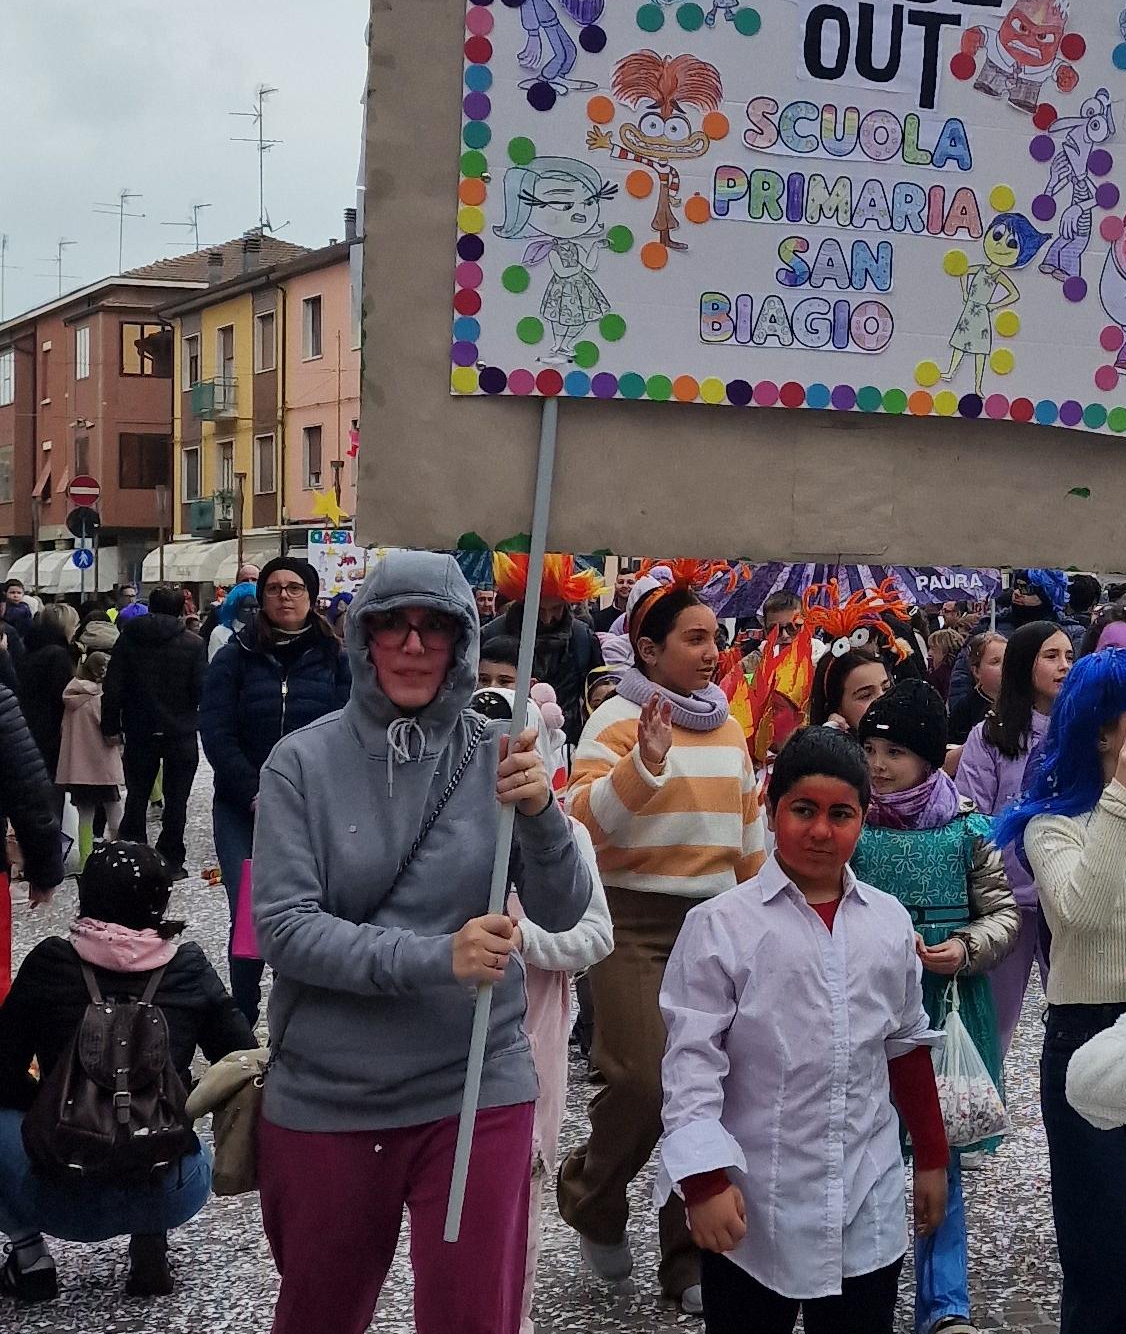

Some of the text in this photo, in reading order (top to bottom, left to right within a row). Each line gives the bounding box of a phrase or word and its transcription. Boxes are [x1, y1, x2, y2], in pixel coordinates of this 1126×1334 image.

[803, 2, 962, 109] OUT
[743, 96, 973, 171] SCUOLA
[713, 165, 984, 239] PRIMARIA
[776, 236, 893, 292] SAN
[700, 292, 894, 351] BIAGIO
[915, 572, 983, 592] PAURA
